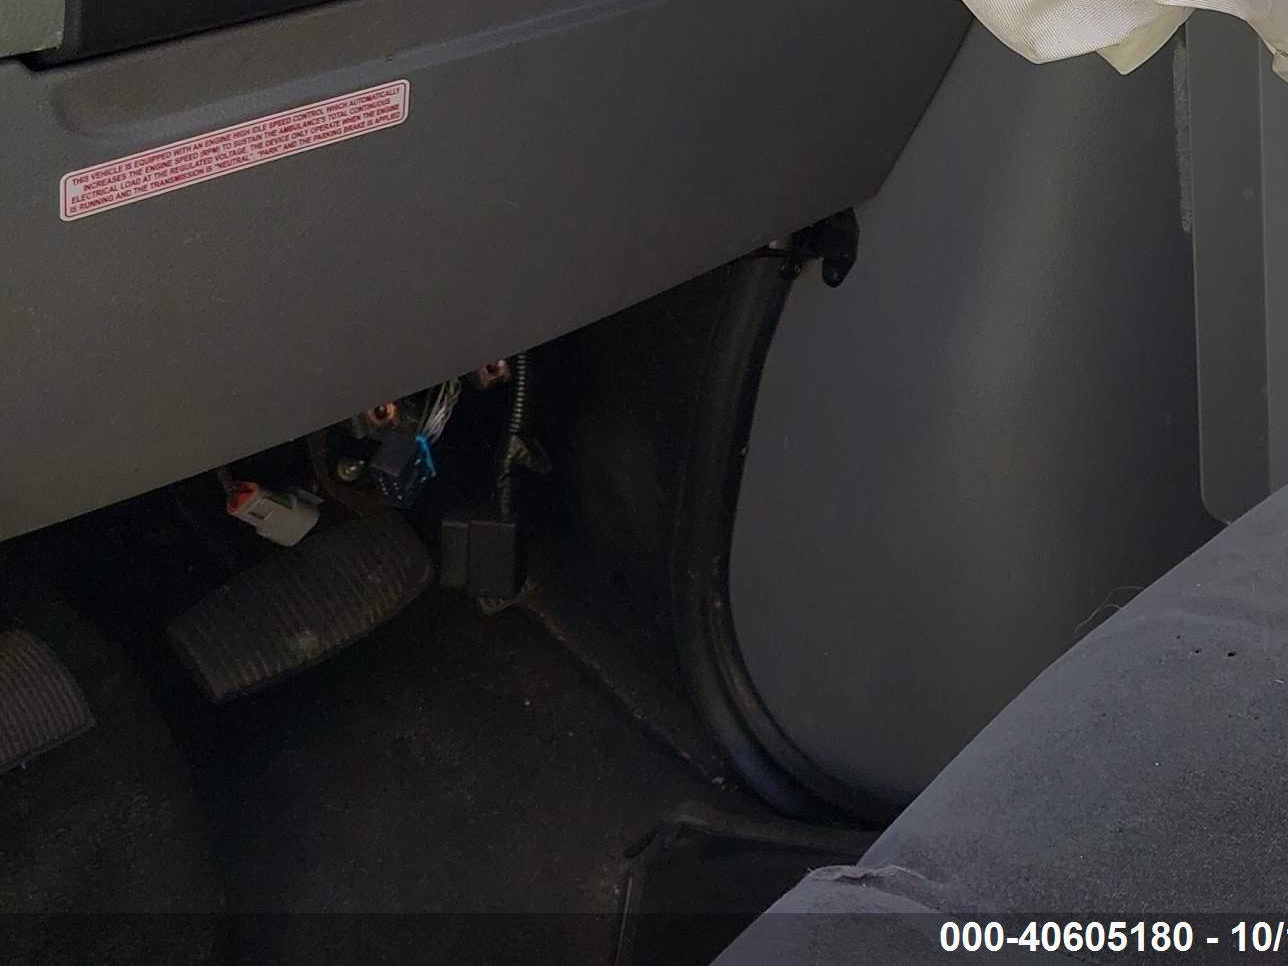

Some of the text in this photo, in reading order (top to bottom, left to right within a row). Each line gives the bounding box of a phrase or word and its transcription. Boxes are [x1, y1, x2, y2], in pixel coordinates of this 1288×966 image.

[70, 205, 77, 213] IS
[79, 195, 114, 211] RUNNING
[115, 189, 132, 200] AND
[133, 184, 148, 194] THE
[150, 168, 204, 189] TRANSMISSION
[283, 141, 297, 150] AND
[298, 136, 312, 146] THE
[312, 127, 342, 142] PARKING
[343, 121, 365, 133] BRAKE
[367, 119, 374, 127] IS
[71, 186, 118, 205] ELECTRICAL
[120, 178, 141, 190] LOAD
[142, 174, 151, 183] AT
[153, 170, 168, 180] THE
[169, 157, 213, 175] REGULATED
[250, 142, 263, 151] THE
[265, 134, 289, 147] DEVICE
[291, 129, 308, 139] ONLY
[310, 119, 340, 134] OPERATE
[342, 115, 361, 125] WHEN
[362, 110, 375, 119] THE
[376, 103, 400, 116] ENGINE
[72, 176, 89, 186] THIS
[91, 167, 123, 180] VEHICLE
[134, 152, 172, 168] EQUIPPED
[173, 146, 192, 156] WITH
[204, 134, 232, 147] ENGINE
[233, 129, 250, 139] HIGH
[252, 124, 267, 133] IDLE
[269, 117, 291, 129] SPEED
[292, 109, 325, 123] CONTROL
[326, 101, 348, 112] WHICH
[349, 87, 401, 107] AUTOMATICALLY
[83, 172, 127, 192] INCREASES
[129, 168, 143, 177] THE
[145, 160, 173, 173] ENGINE
[174, 152, 198, 165] SPEED
[233, 134, 263, 147] SUSTAIN
[264, 129, 277, 138] THE
[328, 110, 348, 121] TOTAL
[349, 98, 391, 115] CONTINUOUS
